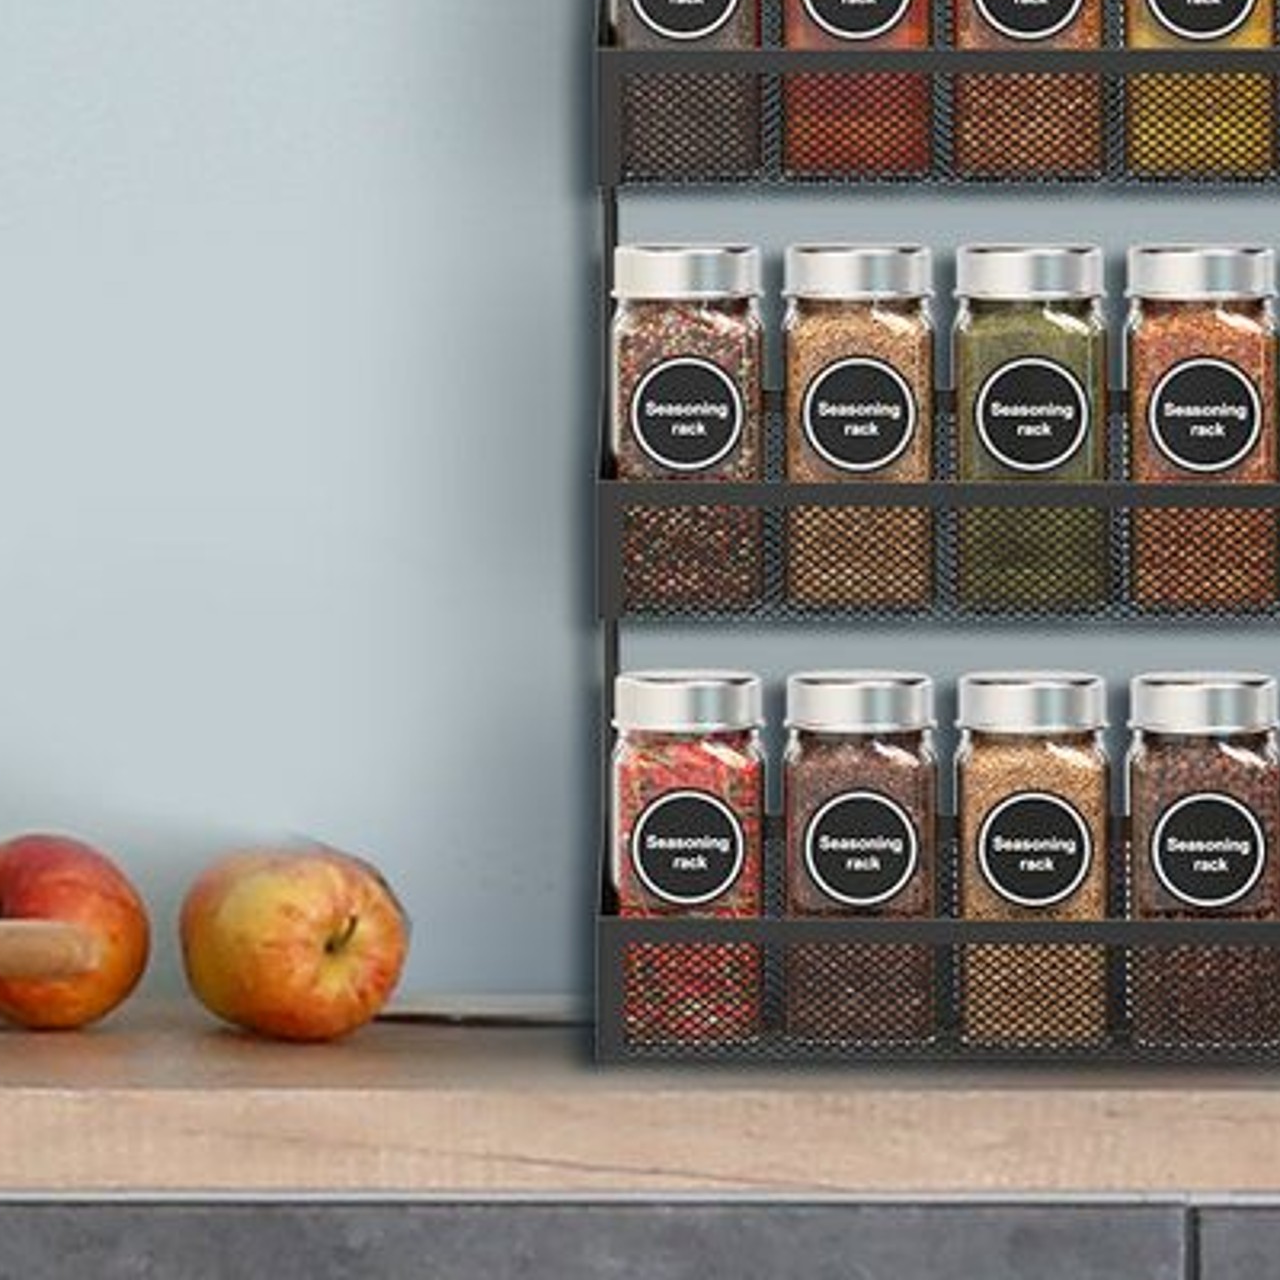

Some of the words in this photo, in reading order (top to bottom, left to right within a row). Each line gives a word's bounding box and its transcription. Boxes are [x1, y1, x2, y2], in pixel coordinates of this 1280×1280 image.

[645, 400, 729, 420] Seasoning
[818, 401, 901, 420] Seasoning
[990, 401, 1075, 420] Seasoning
[1163, 401, 1248, 421] Seasoning
[671, 421, 707, 436] rack
[843, 421, 879, 436] rack
[1016, 422, 1052, 436] rack
[1190, 422, 1226, 437] rack
[646, 834, 730, 853] Seasoning
[819, 834, 904, 854] Seasoning
[992, 835, 1077, 855] Seasoning
[1166, 837, 1251, 856] Seasoning
[672, 854, 708, 870] rack
[845, 856, 881, 871] rack
[1019, 857, 1054, 871] rack
[1193, 857, 1229, 872] rack
